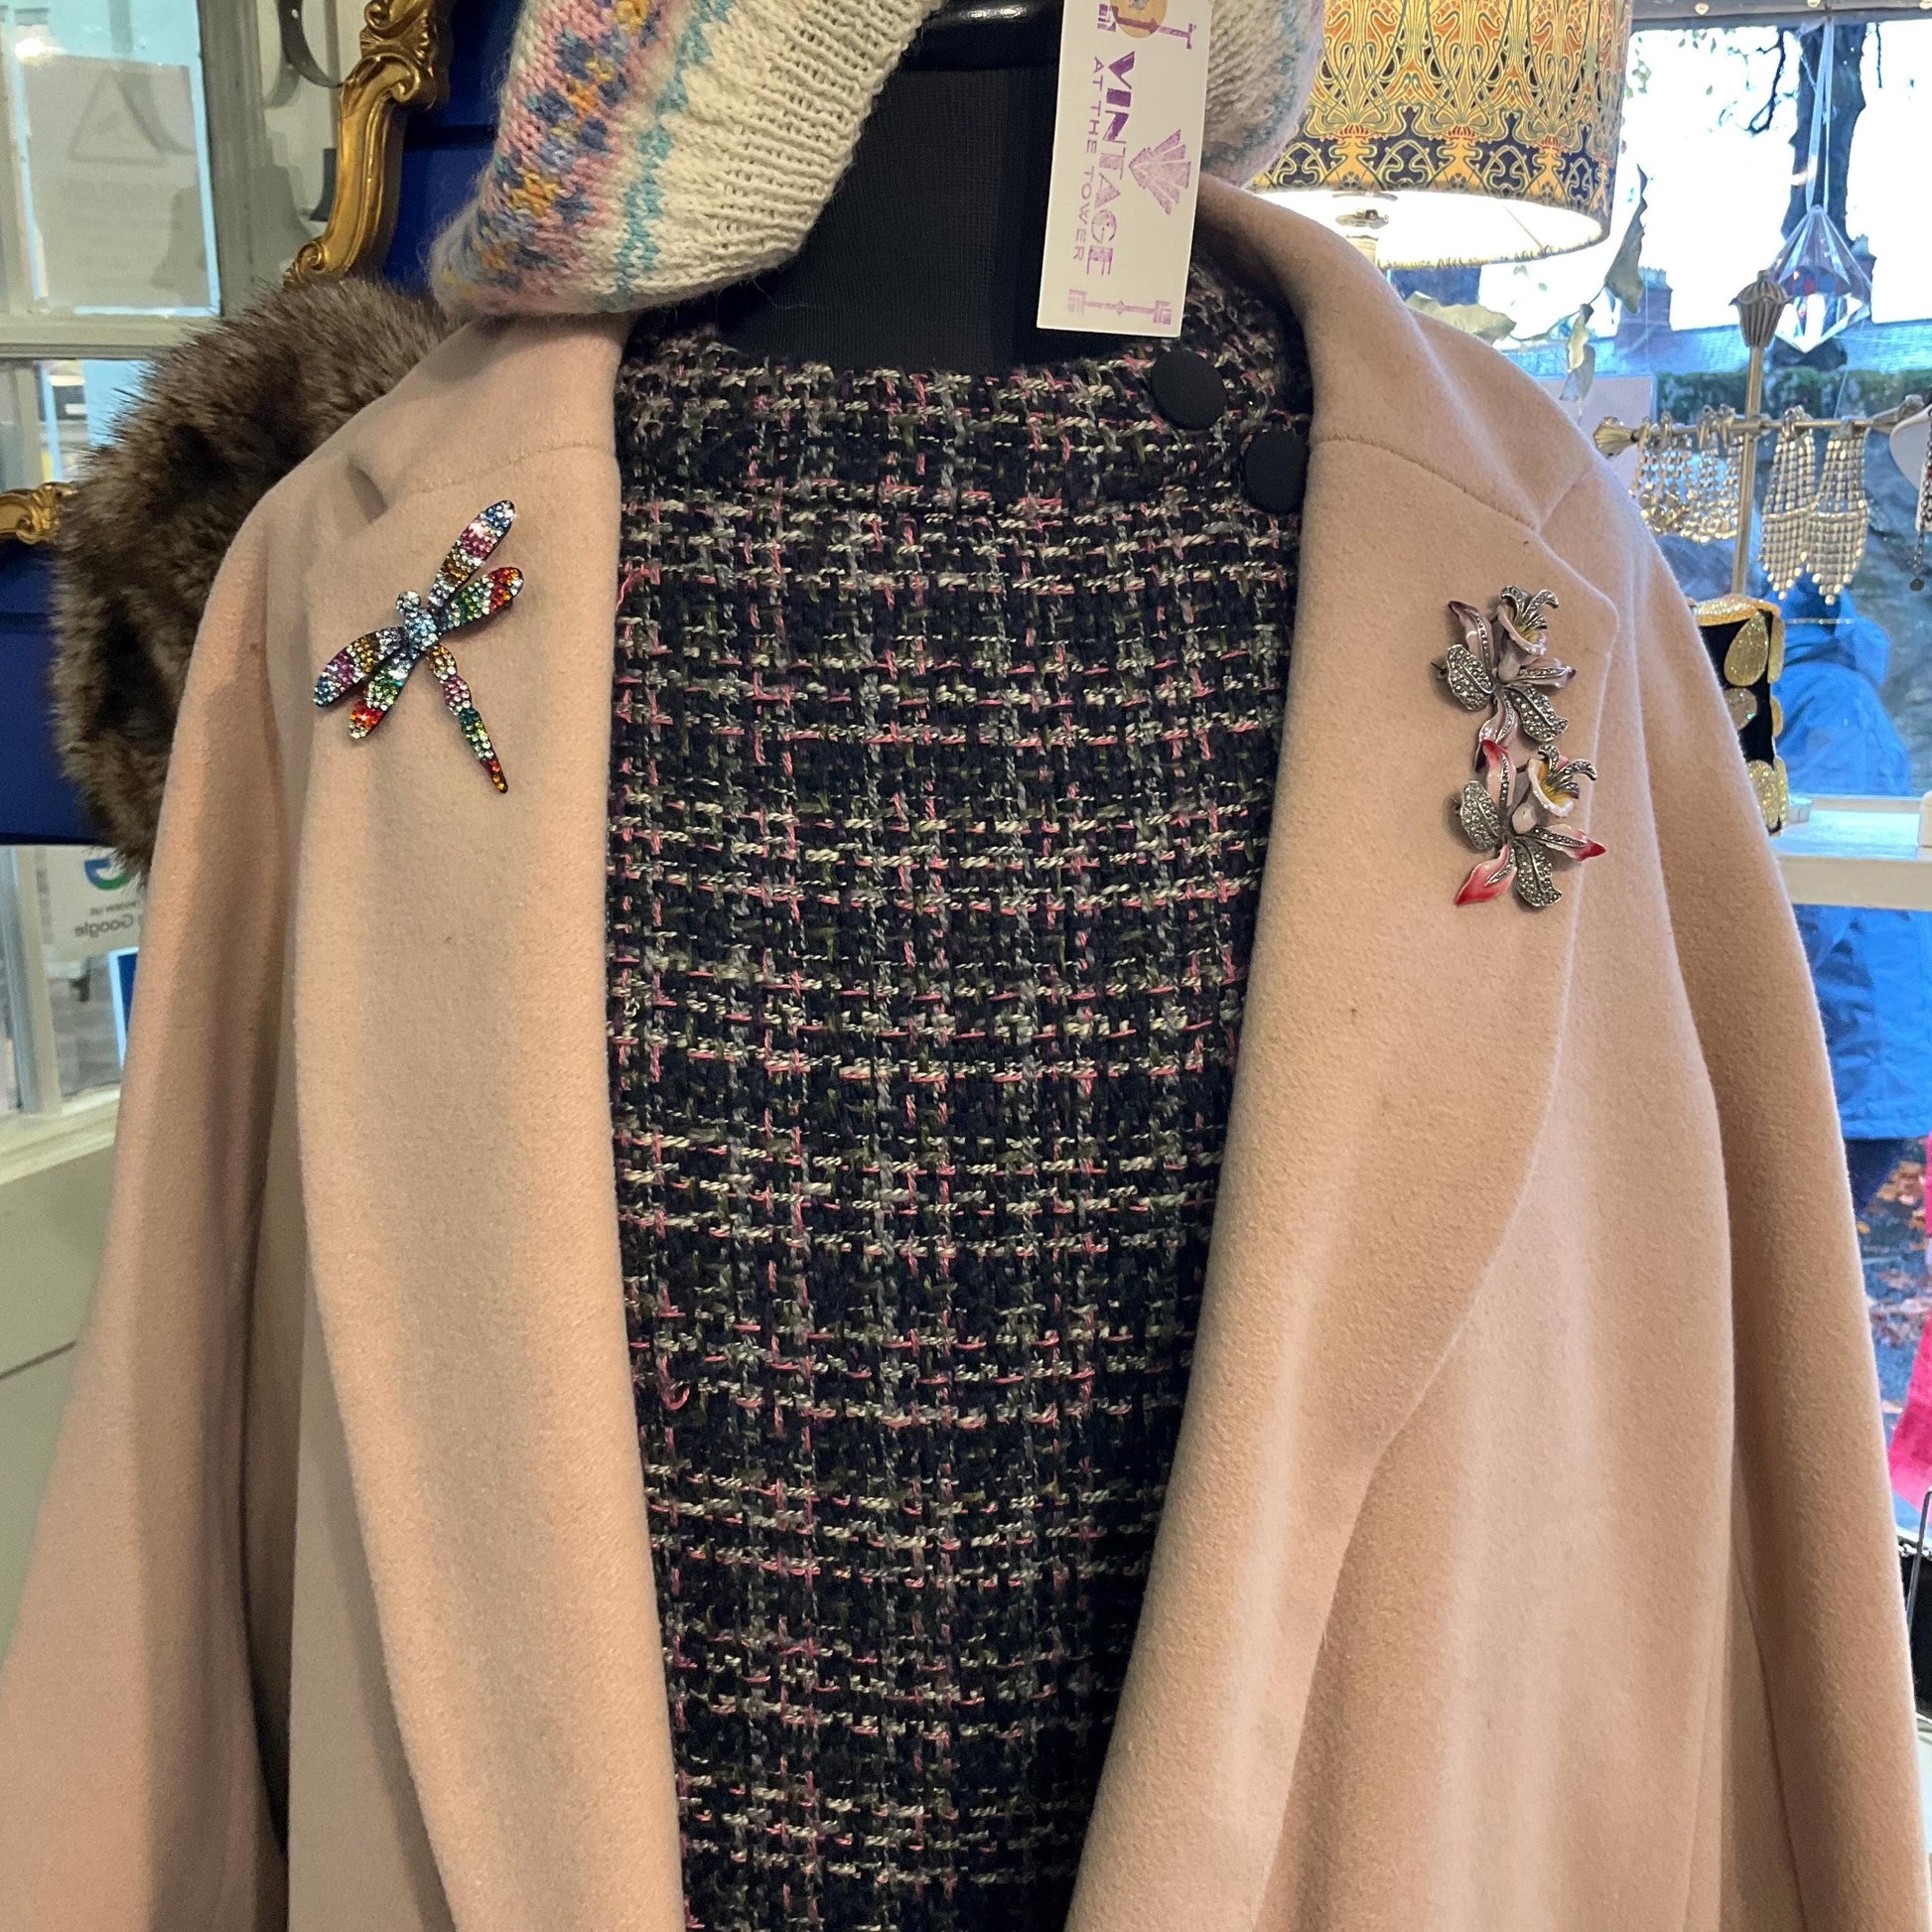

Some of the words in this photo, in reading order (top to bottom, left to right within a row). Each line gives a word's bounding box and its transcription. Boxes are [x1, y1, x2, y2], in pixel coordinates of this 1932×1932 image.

[1092, 57, 1104, 91] AT
[1086, 100, 1102, 154] THE
[1086, 51, 1135, 275] VINTAGE
[1073, 166, 1094, 261] TOWER
